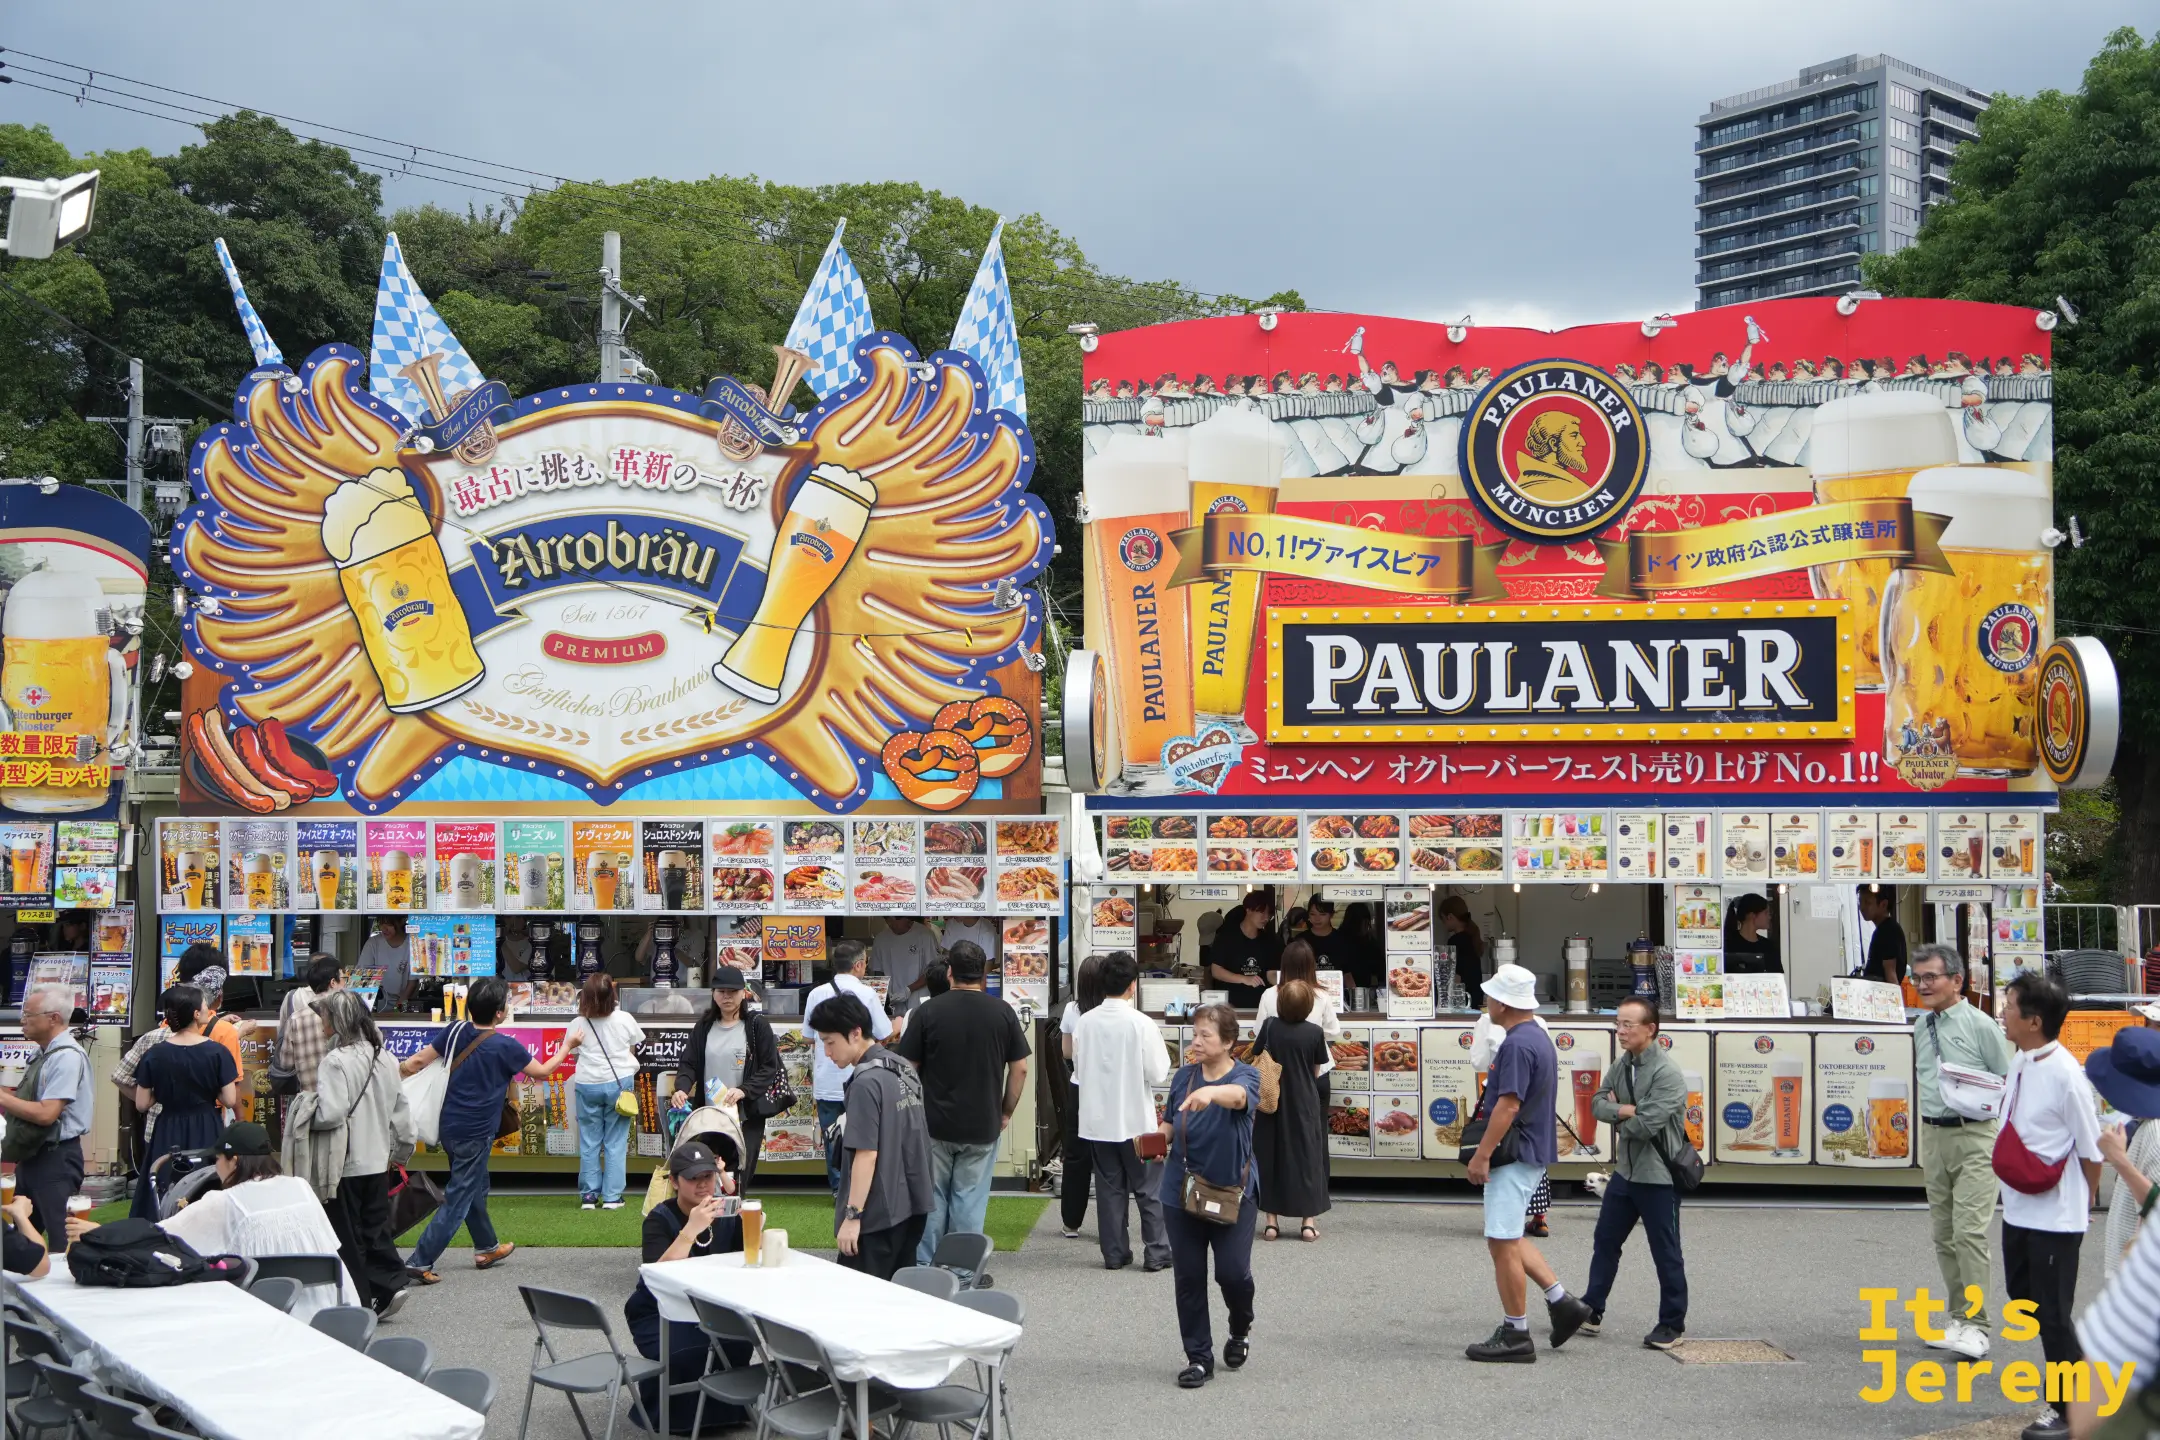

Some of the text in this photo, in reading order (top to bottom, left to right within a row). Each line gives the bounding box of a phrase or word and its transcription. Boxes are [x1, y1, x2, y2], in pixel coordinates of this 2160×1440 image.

[463, 387, 494, 426] 1567
[1483, 371, 1632, 433] PAULANER
[453, 447, 765, 514] 最古に挑む、革新の一杯
[1211, 496, 1247, 512] PAULANER
[1491, 482, 1615, 525] MÜNCHEN
[1121, 529, 1160, 547] PAULANER
[1646, 518, 1898, 574] ドイツ政府公認公式醸造所
[496, 520, 716, 587] Arcobräu
[561, 604, 650, 625] Seit 1567
[1982, 605, 2037, 631] PAULANER
[553, 639, 655, 660] PREMIUM
[1132, 582, 1167, 724] PAULANER
[1305, 629, 1811, 713] PAULANER
[502, 662, 710, 718] Gräfliches Brauhaus
[2042, 665, 2077, 703] PAULANER
[11, 709, 73, 724] eltenburger
[17, 721, 55, 732] Kloster
[1174, 750, 1233, 778] Oktoberfest
[1249, 755, 1375, 785] ミュンヘン
[1905, 760, 1949, 768] PAULANER
[0, 762, 109, 786] 型ジョッキ!
[1911, 768, 1945, 780] Salvator
[4, 832, 44, 841] ヴァイスビア
[368, 829, 426, 841] シュロスヘル
[511, 829, 557, 841] リーズル
[575, 829, 632, 841] ツヴィックル
[643, 829, 702, 841] シュロスドゥンケル
[1189, 889, 1228, 897] フード提供口
[1332, 888, 1373, 897] フード注文口
[1937, 888, 1983, 897] グラス返却口
[165, 922, 218, 937] ビールレジ
[765, 924, 821, 938] フードレジ
[169, 936, 215, 945] Beer Cashier
[768, 939, 789, 949] Food
[791, 939, 820, 949] Cashier
[391, 1030, 428, 1038] アルコブロイ
[1818, 1063, 1886, 1072] OKTOBERFEST BIER
[267, 1097, 276, 1116] 日本
[1783, 1096, 1792, 1138] PAULANER
